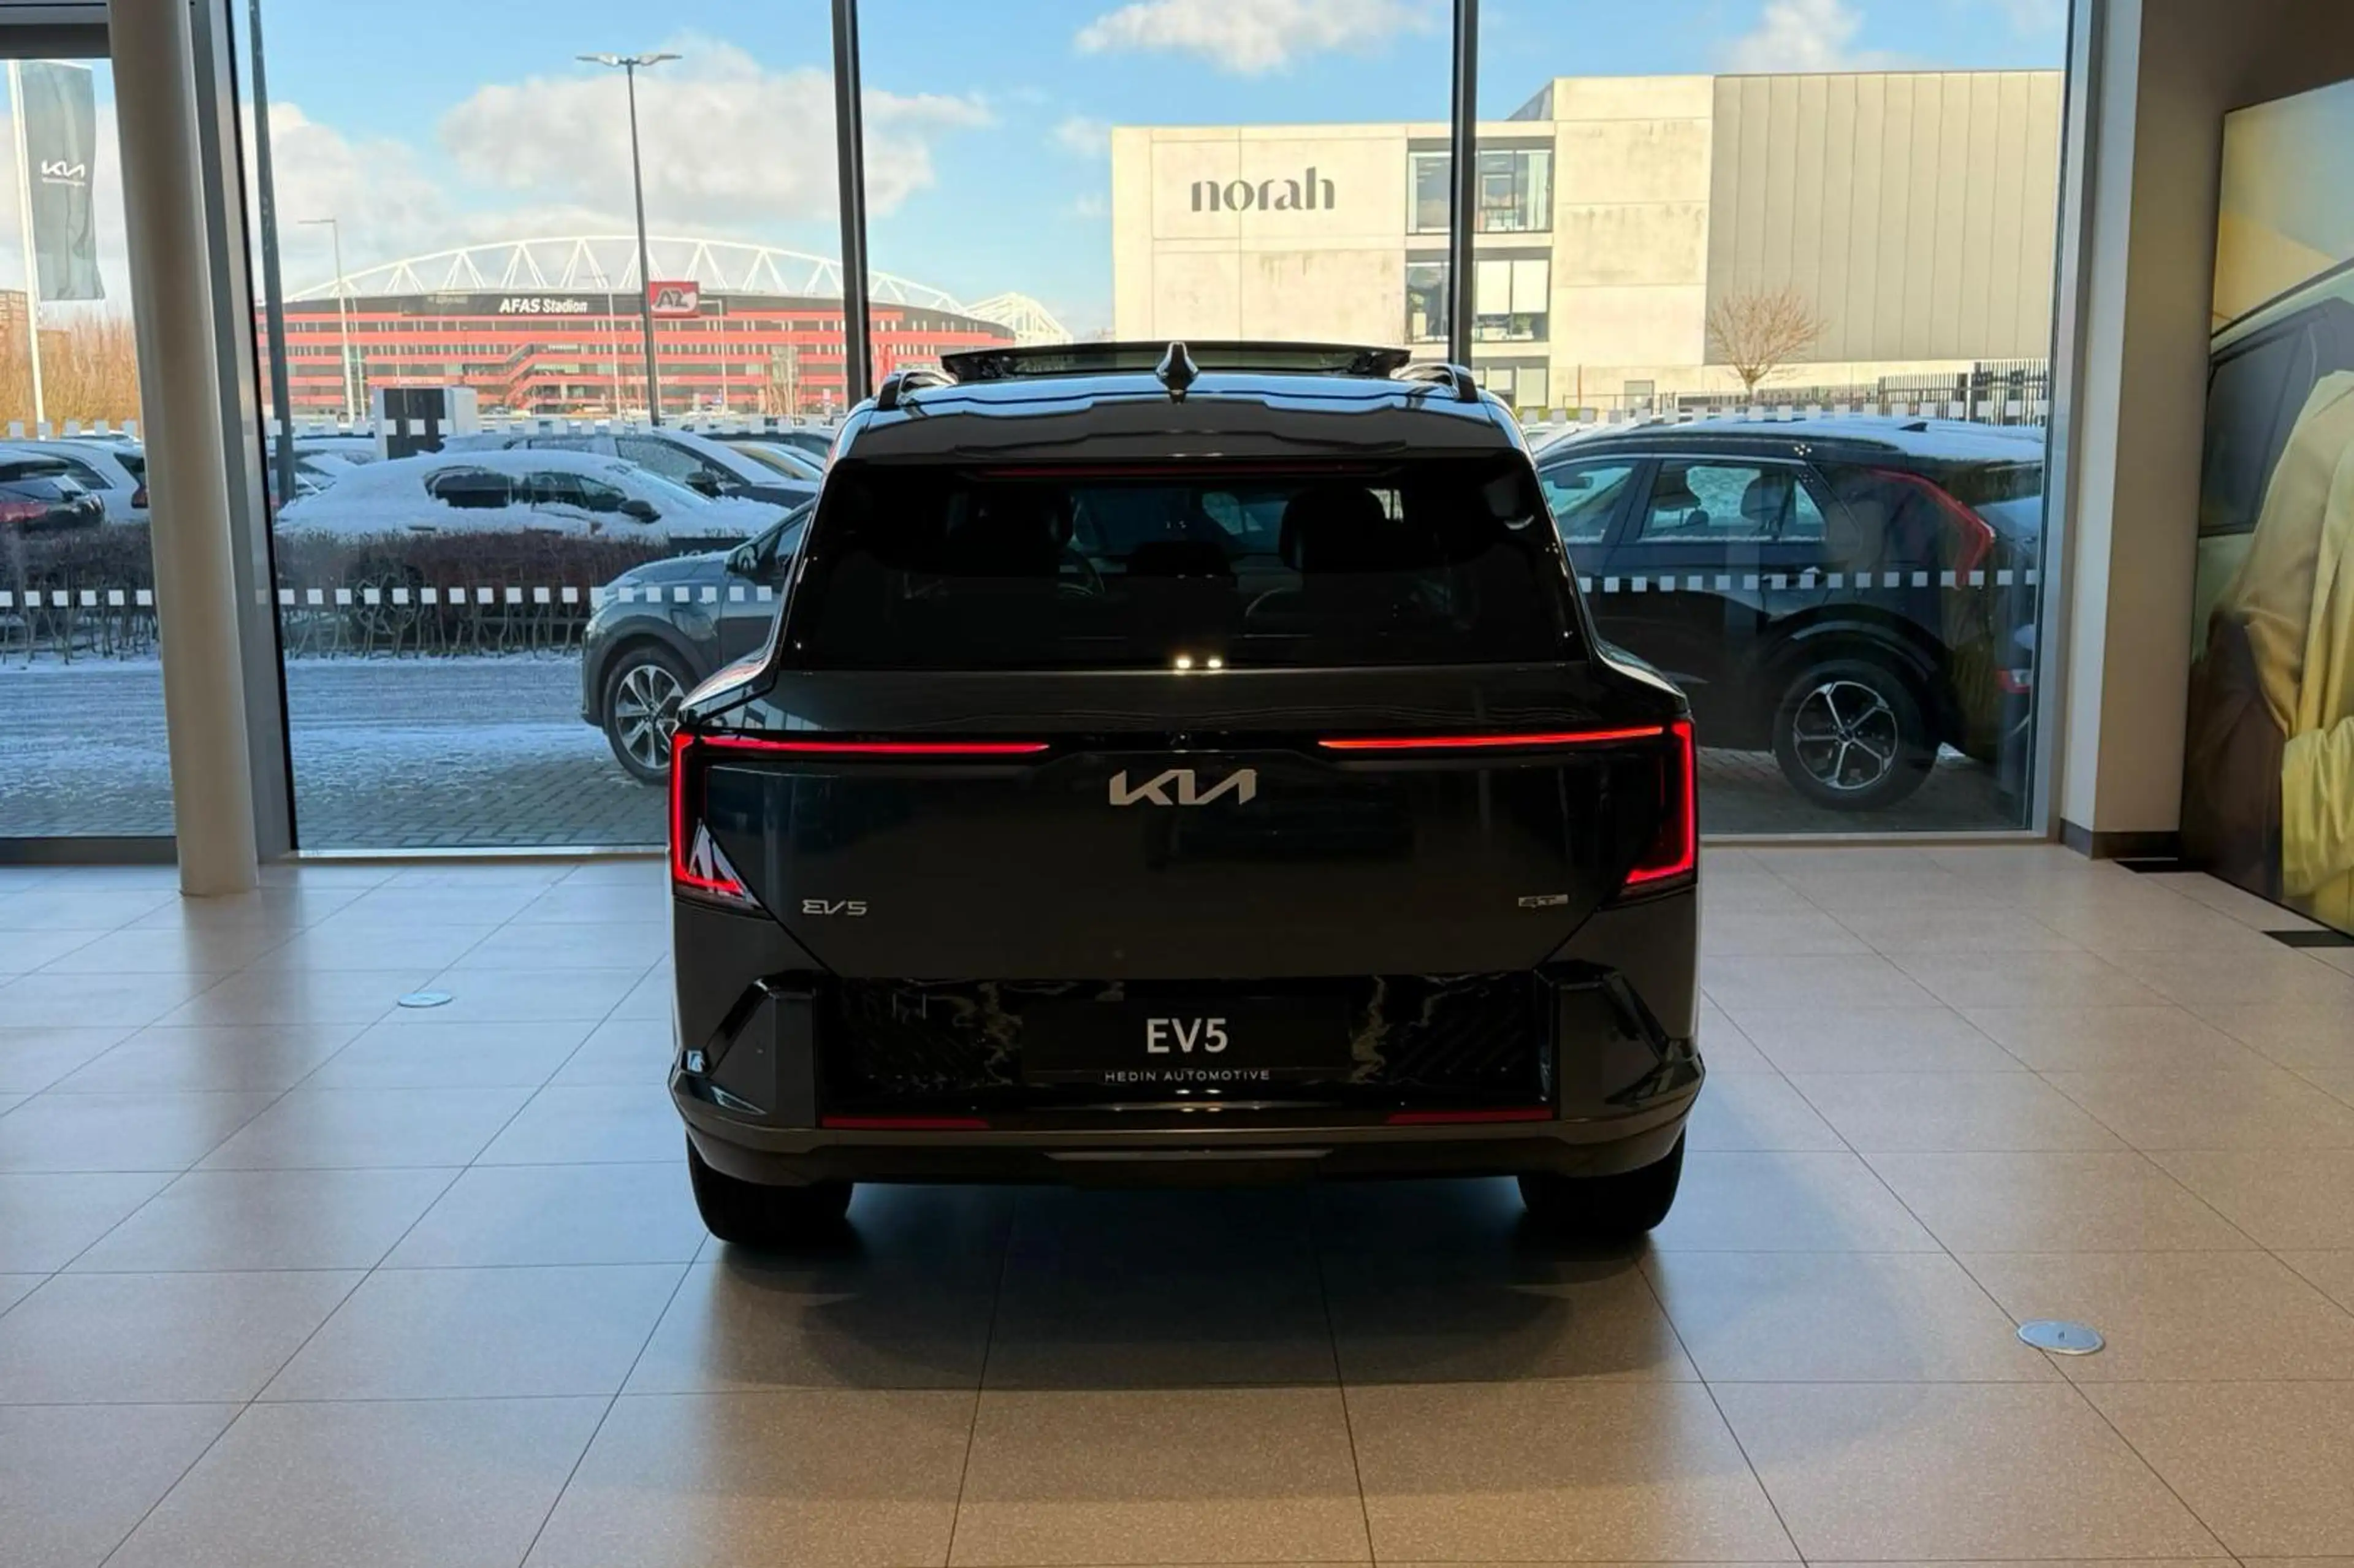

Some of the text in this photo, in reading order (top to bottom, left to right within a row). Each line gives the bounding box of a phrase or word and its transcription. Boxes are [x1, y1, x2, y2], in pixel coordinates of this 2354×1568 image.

[41, 160, 85, 178] KIA
[1192, 166, 1335, 212] norah
[499, 298, 588, 314] AFAS Stadion
[657, 290, 689, 308] AZ
[1109, 769, 1257, 805] KIA
[802, 899, 867, 915] EV5
[1146, 1018, 1228, 1054] EV5
[1105, 1070, 1271, 1083] HEDIN AUTOMOTIVE
